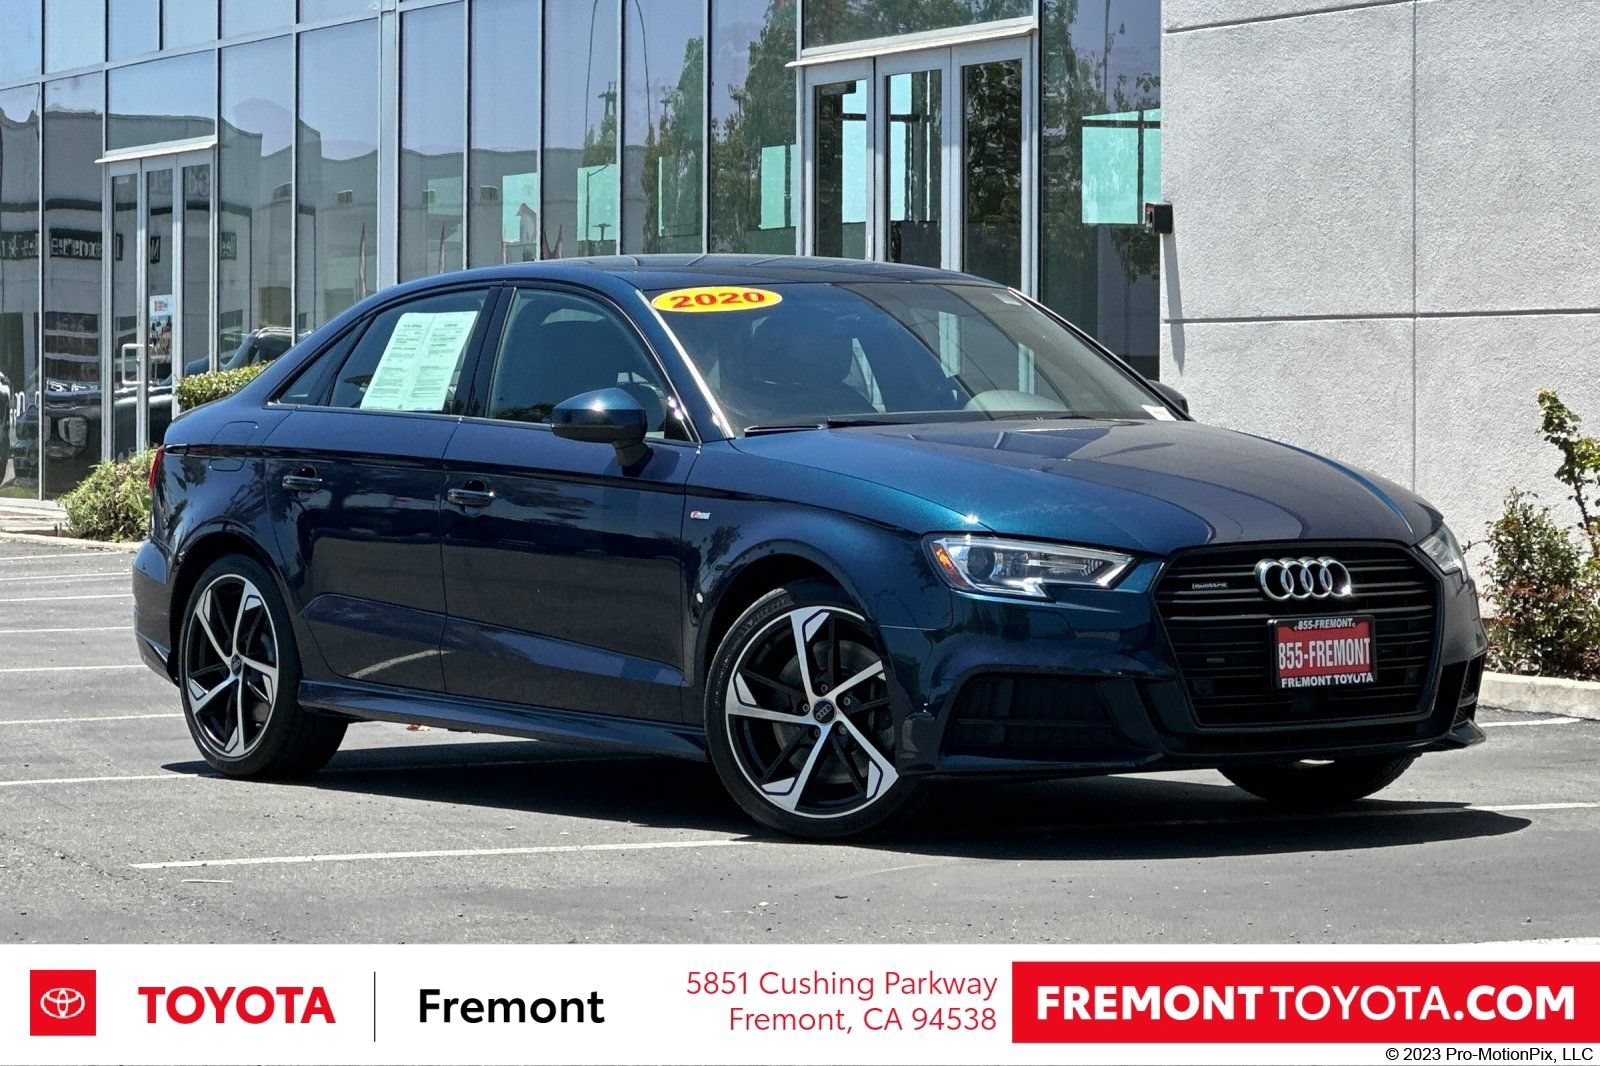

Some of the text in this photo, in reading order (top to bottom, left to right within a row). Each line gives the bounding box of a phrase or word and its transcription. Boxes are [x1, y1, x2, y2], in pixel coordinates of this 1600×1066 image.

[670, 291, 765, 308] 2020
[1298, 618, 1353, 630] 855-FREMONT
[1278, 638, 1370, 670] 855-FREMONT
[1281, 672, 1374, 689] FREMONT TOYOTA
